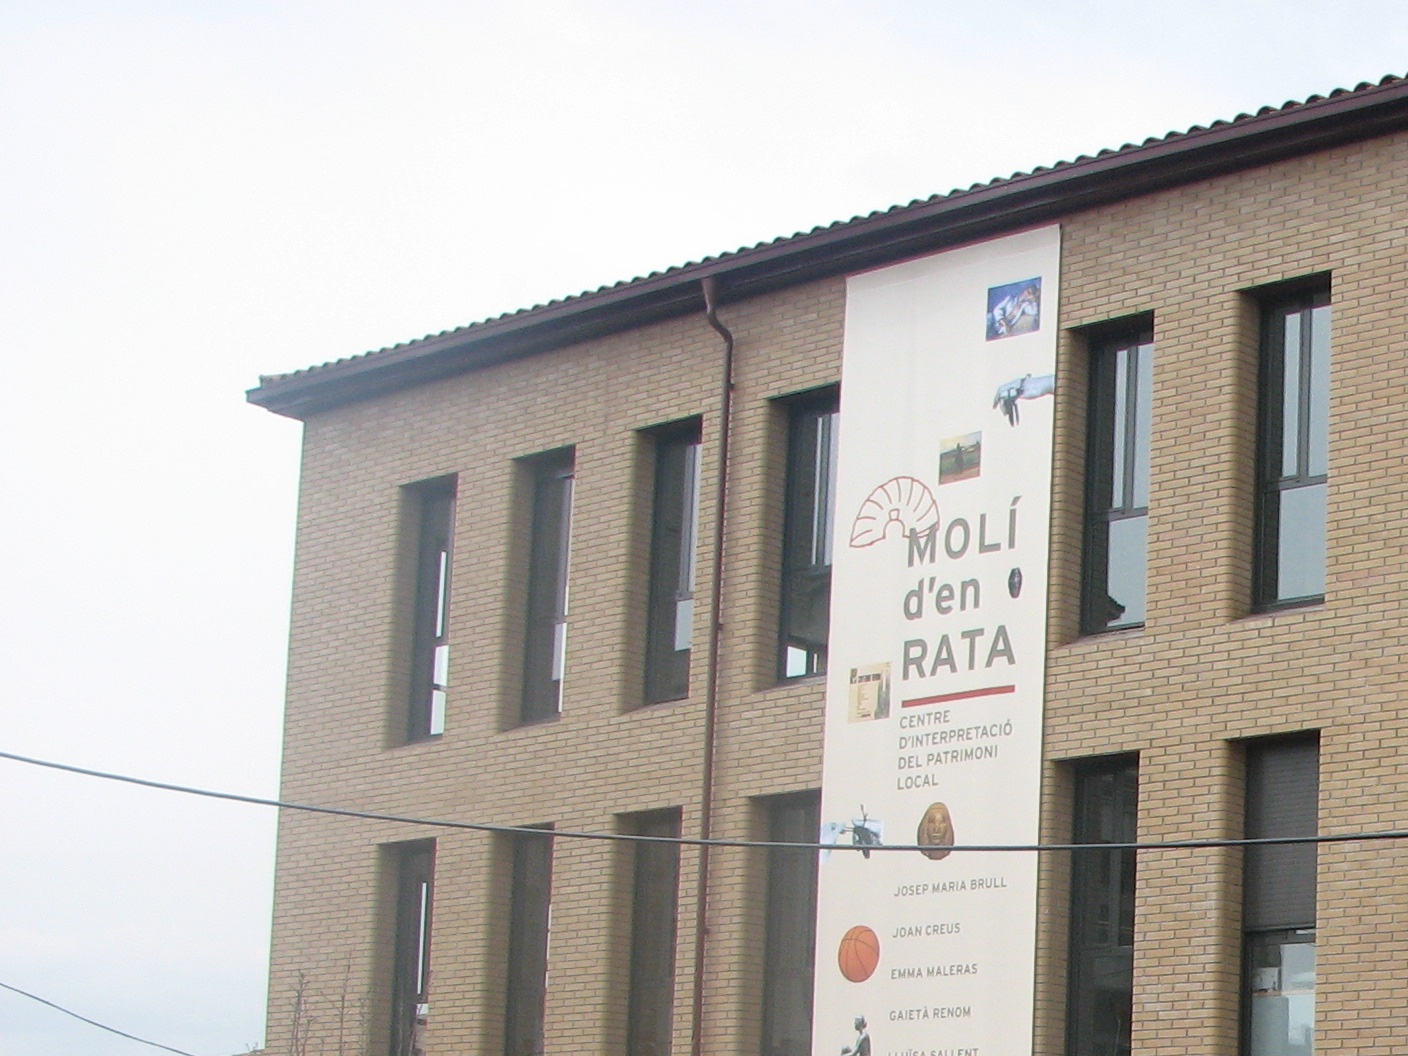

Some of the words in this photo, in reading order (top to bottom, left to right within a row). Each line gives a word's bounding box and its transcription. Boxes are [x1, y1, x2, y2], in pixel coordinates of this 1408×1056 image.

[907, 496, 1023, 568] MOLÍ
[903, 576, 981, 621] d'en
[902, 624, 1016, 682] RATA
[898, 710, 951, 730] CENTRE
[898, 719, 1013, 750] D'INTERPRETACIÓ
[897, 751, 923, 770] DEL
[926, 745, 999, 767] PATRIMONI
[896, 773, 939, 791] LOCAL
[893, 883, 929, 898] JOSEP
[931, 880, 967, 894] MARIA
[970, 877, 1008, 891] BRULL
[892, 924, 923, 939] JOAN
[925, 923, 961, 937] CREUS
[890, 966, 924, 980] EMMA
[926, 963, 978, 978] MALERAS
[889, 1006, 930, 1021] GAIETÀ
[932, 1006, 972, 1019] RENOM
